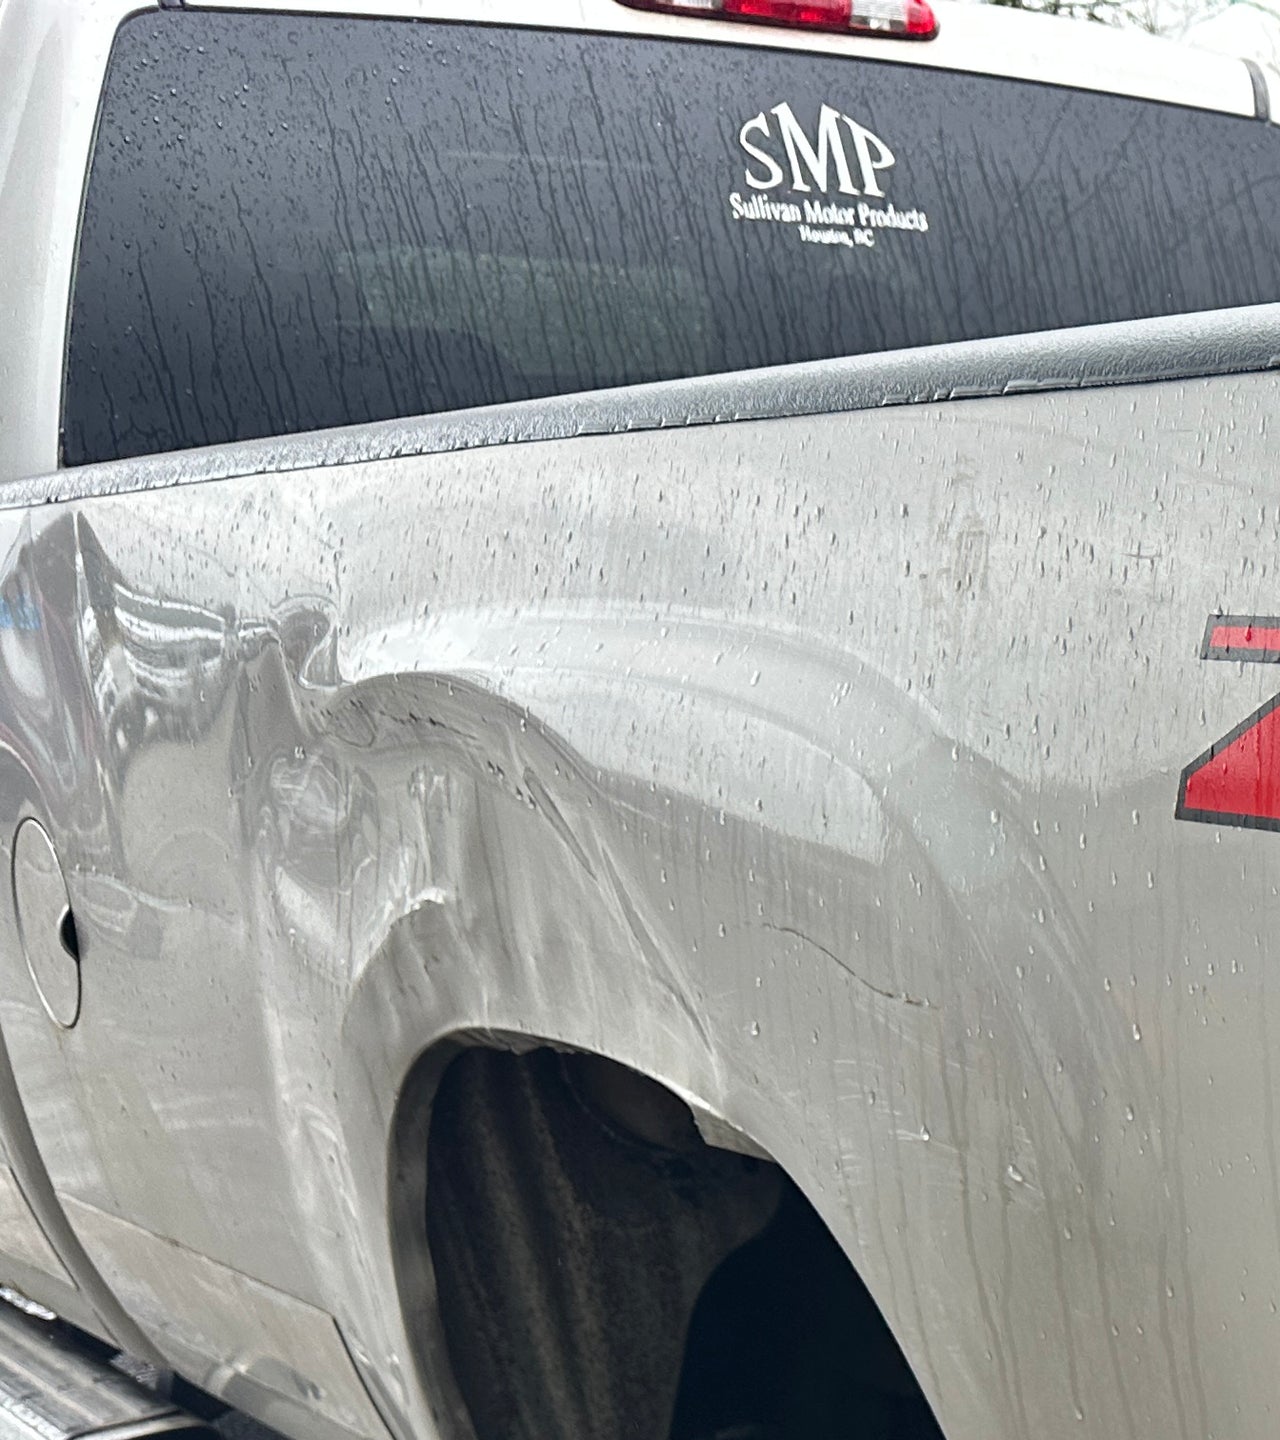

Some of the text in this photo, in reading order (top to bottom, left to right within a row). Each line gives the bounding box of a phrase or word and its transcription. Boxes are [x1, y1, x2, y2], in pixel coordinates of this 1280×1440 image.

[739, 101, 895, 198] SMP
[729, 192, 928, 232] Sullivan Motor Products
